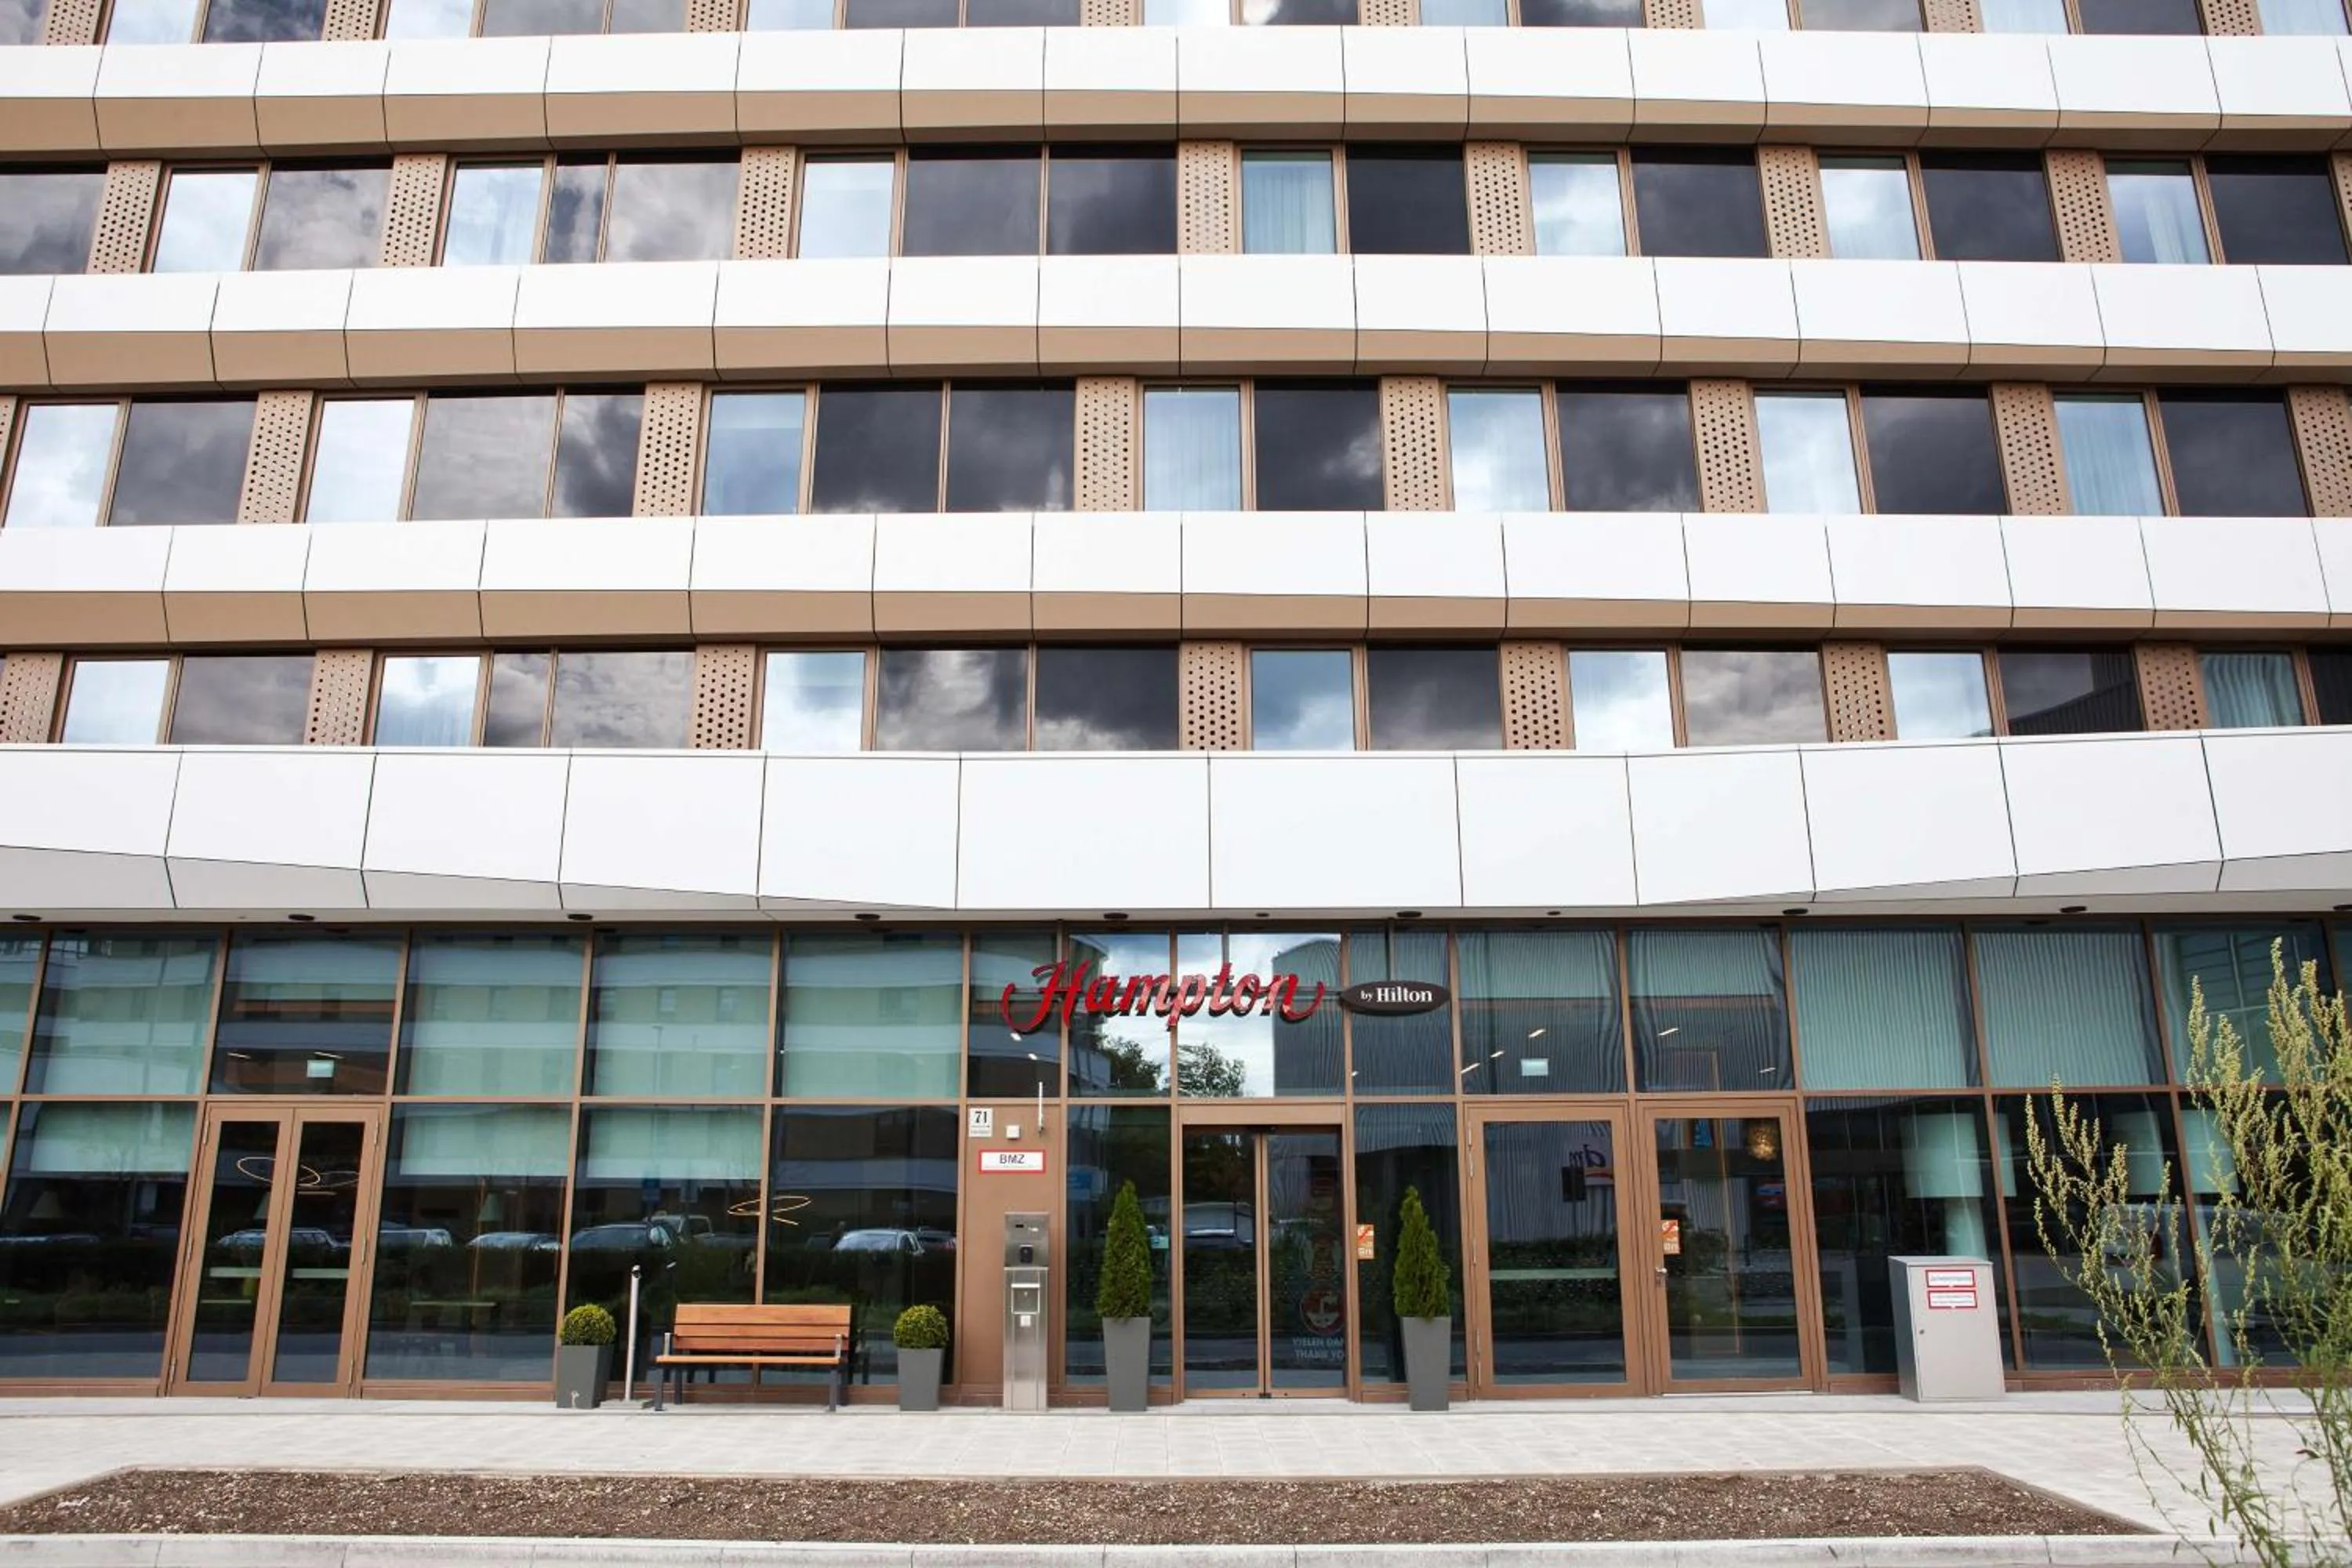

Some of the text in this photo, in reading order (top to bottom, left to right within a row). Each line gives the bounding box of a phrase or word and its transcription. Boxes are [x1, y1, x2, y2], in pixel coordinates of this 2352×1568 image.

[1002, 959, 1325, 1032] Hampton
[1359, 986, 1433, 1002] by Hilton
[975, 1110, 987, 1123] 71
[1000, 1154, 1025, 1164] BMZ
